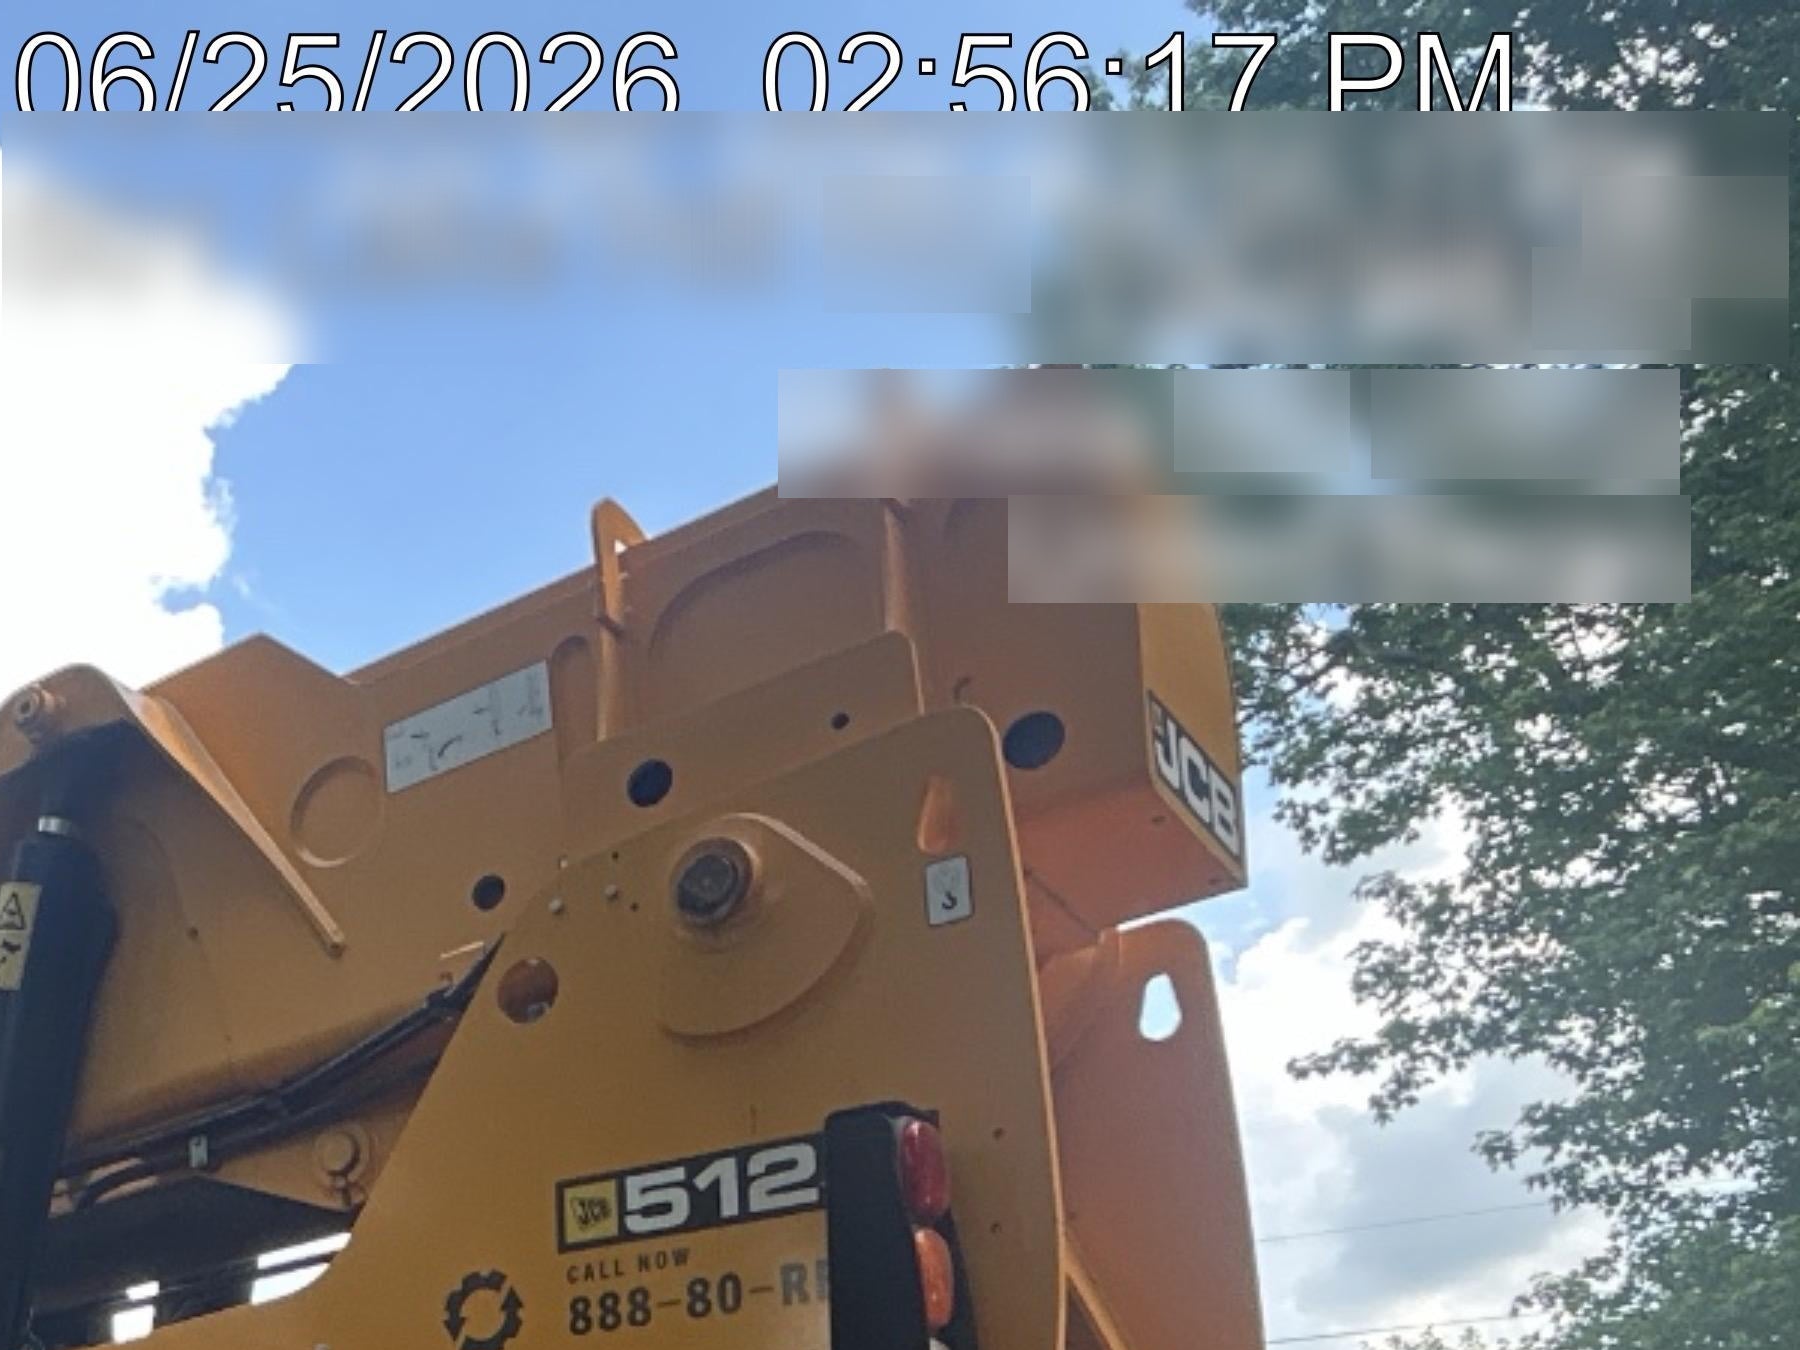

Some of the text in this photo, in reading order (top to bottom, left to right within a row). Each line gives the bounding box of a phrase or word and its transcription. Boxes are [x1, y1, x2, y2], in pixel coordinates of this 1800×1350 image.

[1154, 712, 1241, 856] JCB
[623, 1143, 819, 1234] 512
[566, 1248, 690, 1285] CALL NOW
